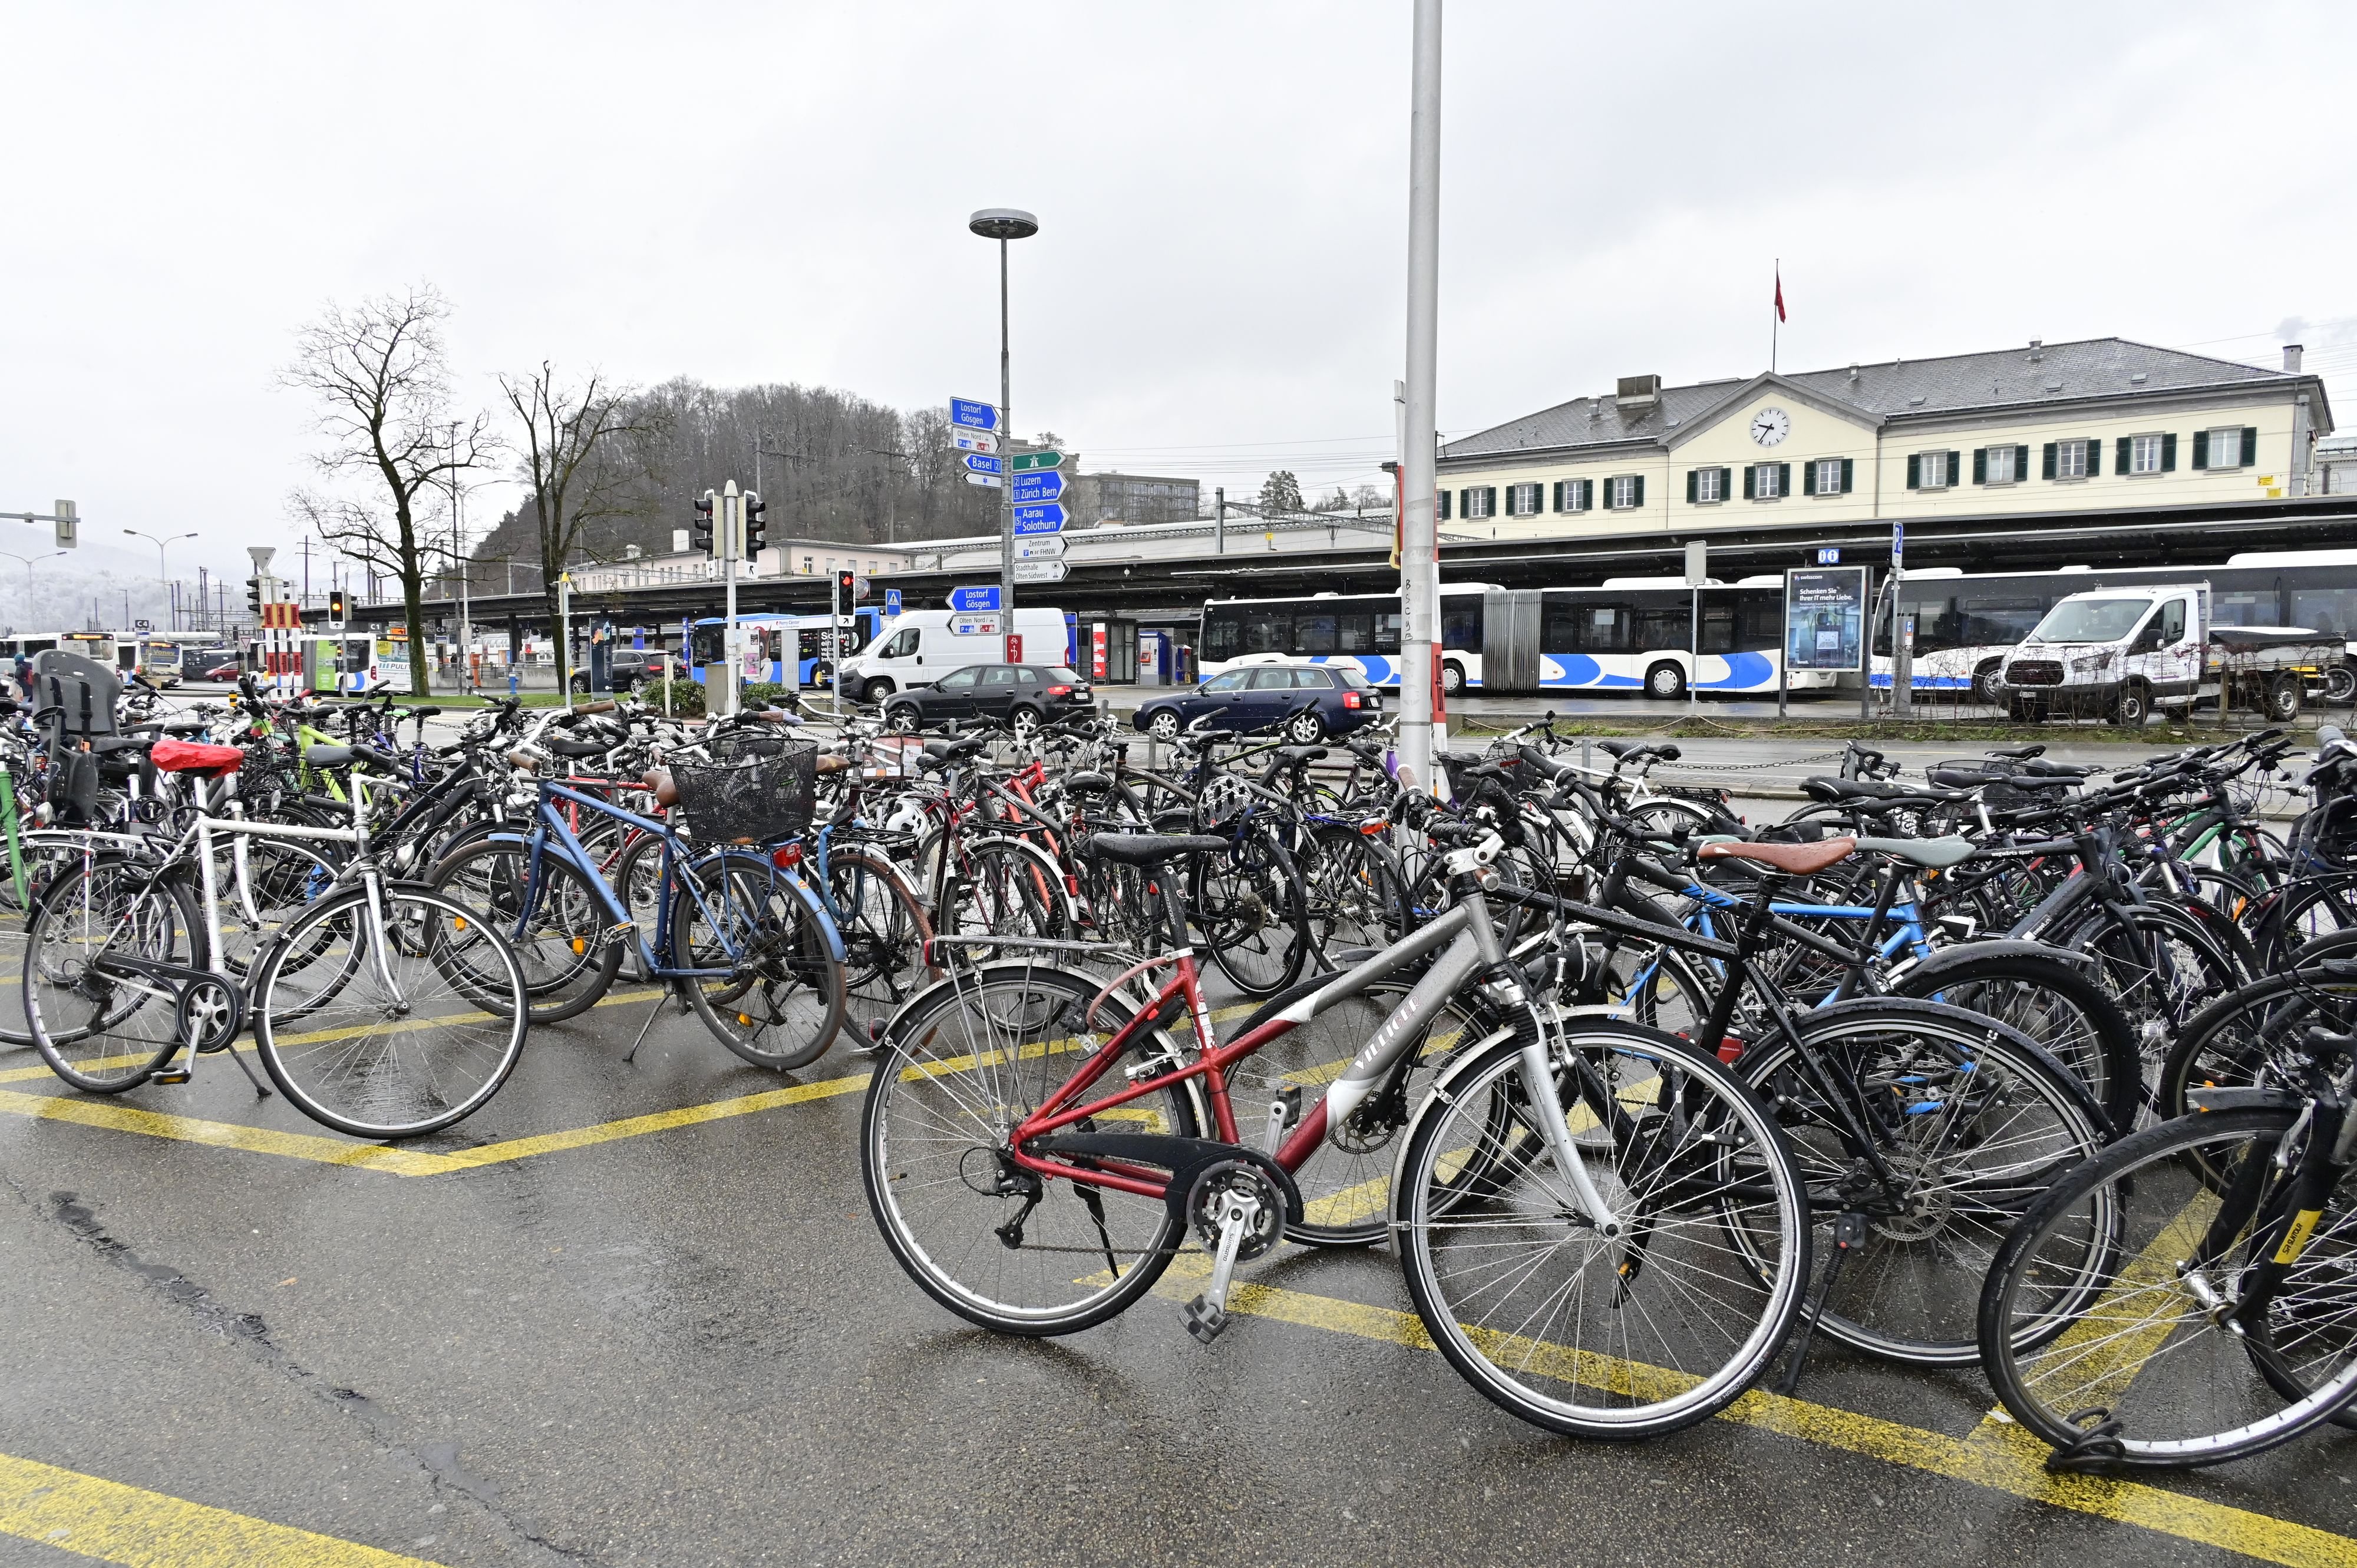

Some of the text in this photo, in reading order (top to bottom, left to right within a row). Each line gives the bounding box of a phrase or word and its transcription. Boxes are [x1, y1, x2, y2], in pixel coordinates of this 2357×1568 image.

[960, 402, 982, 414] Lostorf
[961, 413, 983, 426] Gösgen
[972, 457, 992, 470] Basel
[1021, 476, 1041, 486] Luzern
[1021, 488, 1039, 499] Zürich
[1042, 487, 1057, 497] Bern
[1022, 509, 1044, 519] Aarau
[1022, 521, 1057, 532] Solothurn
[966, 589, 988, 599] Lostorf
[966, 600, 990, 609] Gösgen
[2033, 918, 2052, 936] simpel.ch
[1400, 921, 1442, 948] VANCOUVER
[1354, 996, 1420, 1071] VILLIGER
[1754, 1356, 1765, 1371] LITE
